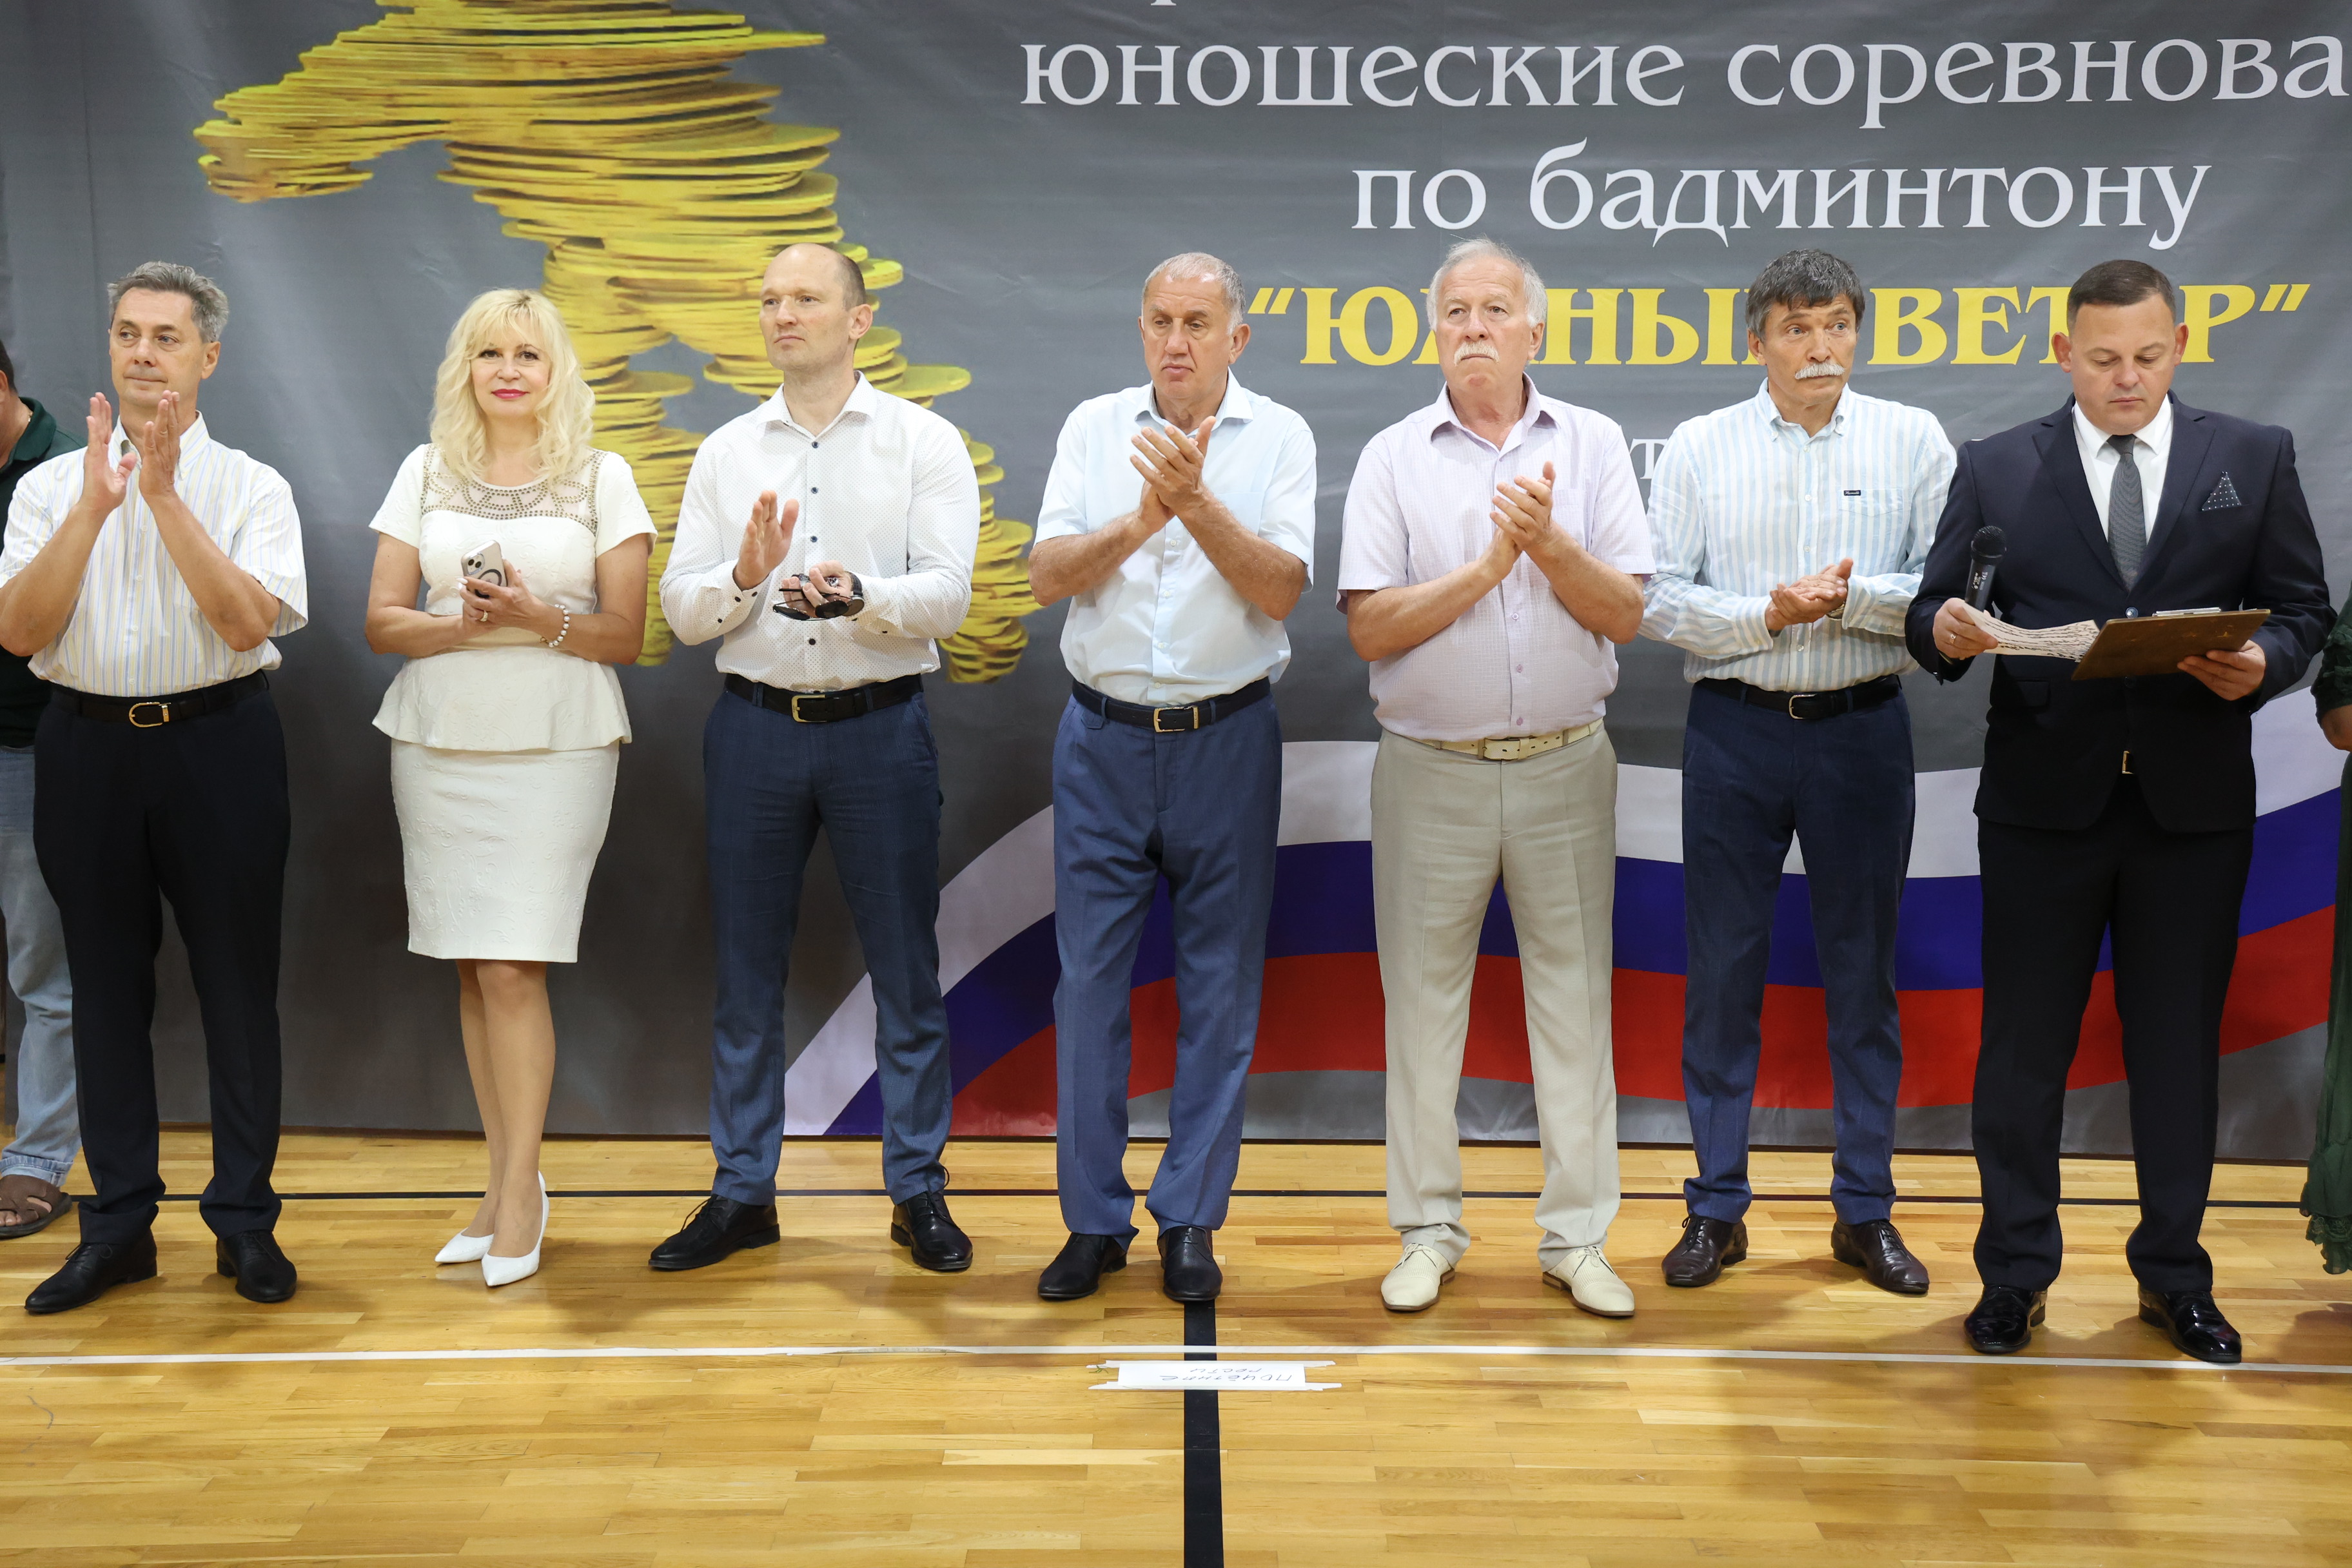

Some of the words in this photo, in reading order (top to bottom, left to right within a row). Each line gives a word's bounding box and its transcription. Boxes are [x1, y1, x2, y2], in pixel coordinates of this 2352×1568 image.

[1020, 43, 1685, 107] юношеские
[1727, 35, 2350, 129] соревнова
[1351, 169, 1487, 230] по
[1529, 137, 2212, 250] бадминтону
[1248, 286, 1767, 366] "ЮНЫ
[1867, 283, 2311, 365] ВЕТР"
